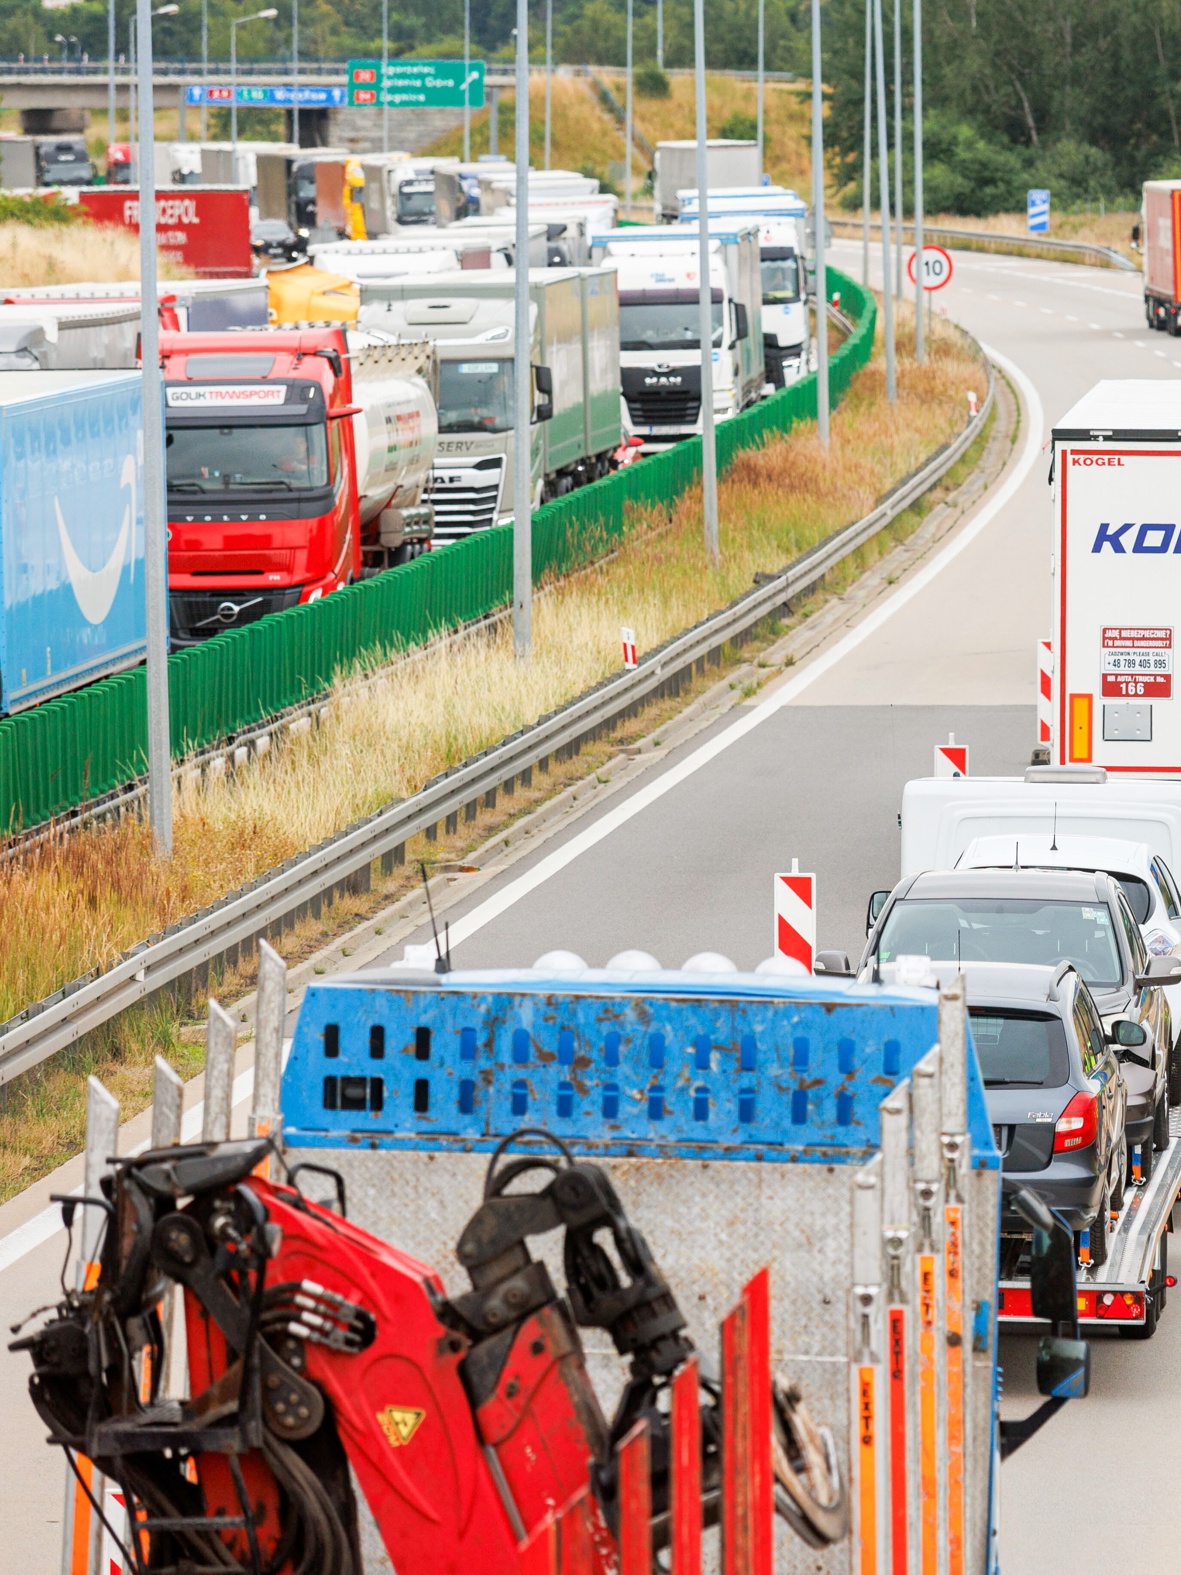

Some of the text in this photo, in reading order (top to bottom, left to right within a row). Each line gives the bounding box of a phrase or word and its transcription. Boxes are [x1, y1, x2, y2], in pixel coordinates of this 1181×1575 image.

[924, 259, 943, 277] 10
[644, 376, 682, 386] MAN
[208, 389, 282, 400] TRANSPORT
[437, 441, 474, 453] SERV
[1072, 456, 1125, 467] KÖGEL
[426, 475, 462, 484] AF
[185, 514, 267, 522] VOLVO
[1104, 629, 1170, 639] JADĘ NIEBEZPIECZNIE?
[1123, 659, 1136, 668] 789
[1138, 659, 1151, 669] 405
[1153, 659, 1167, 669] 895
[1120, 682, 1145, 695] 166
[1028, 1111, 1054, 1119] Fabia
